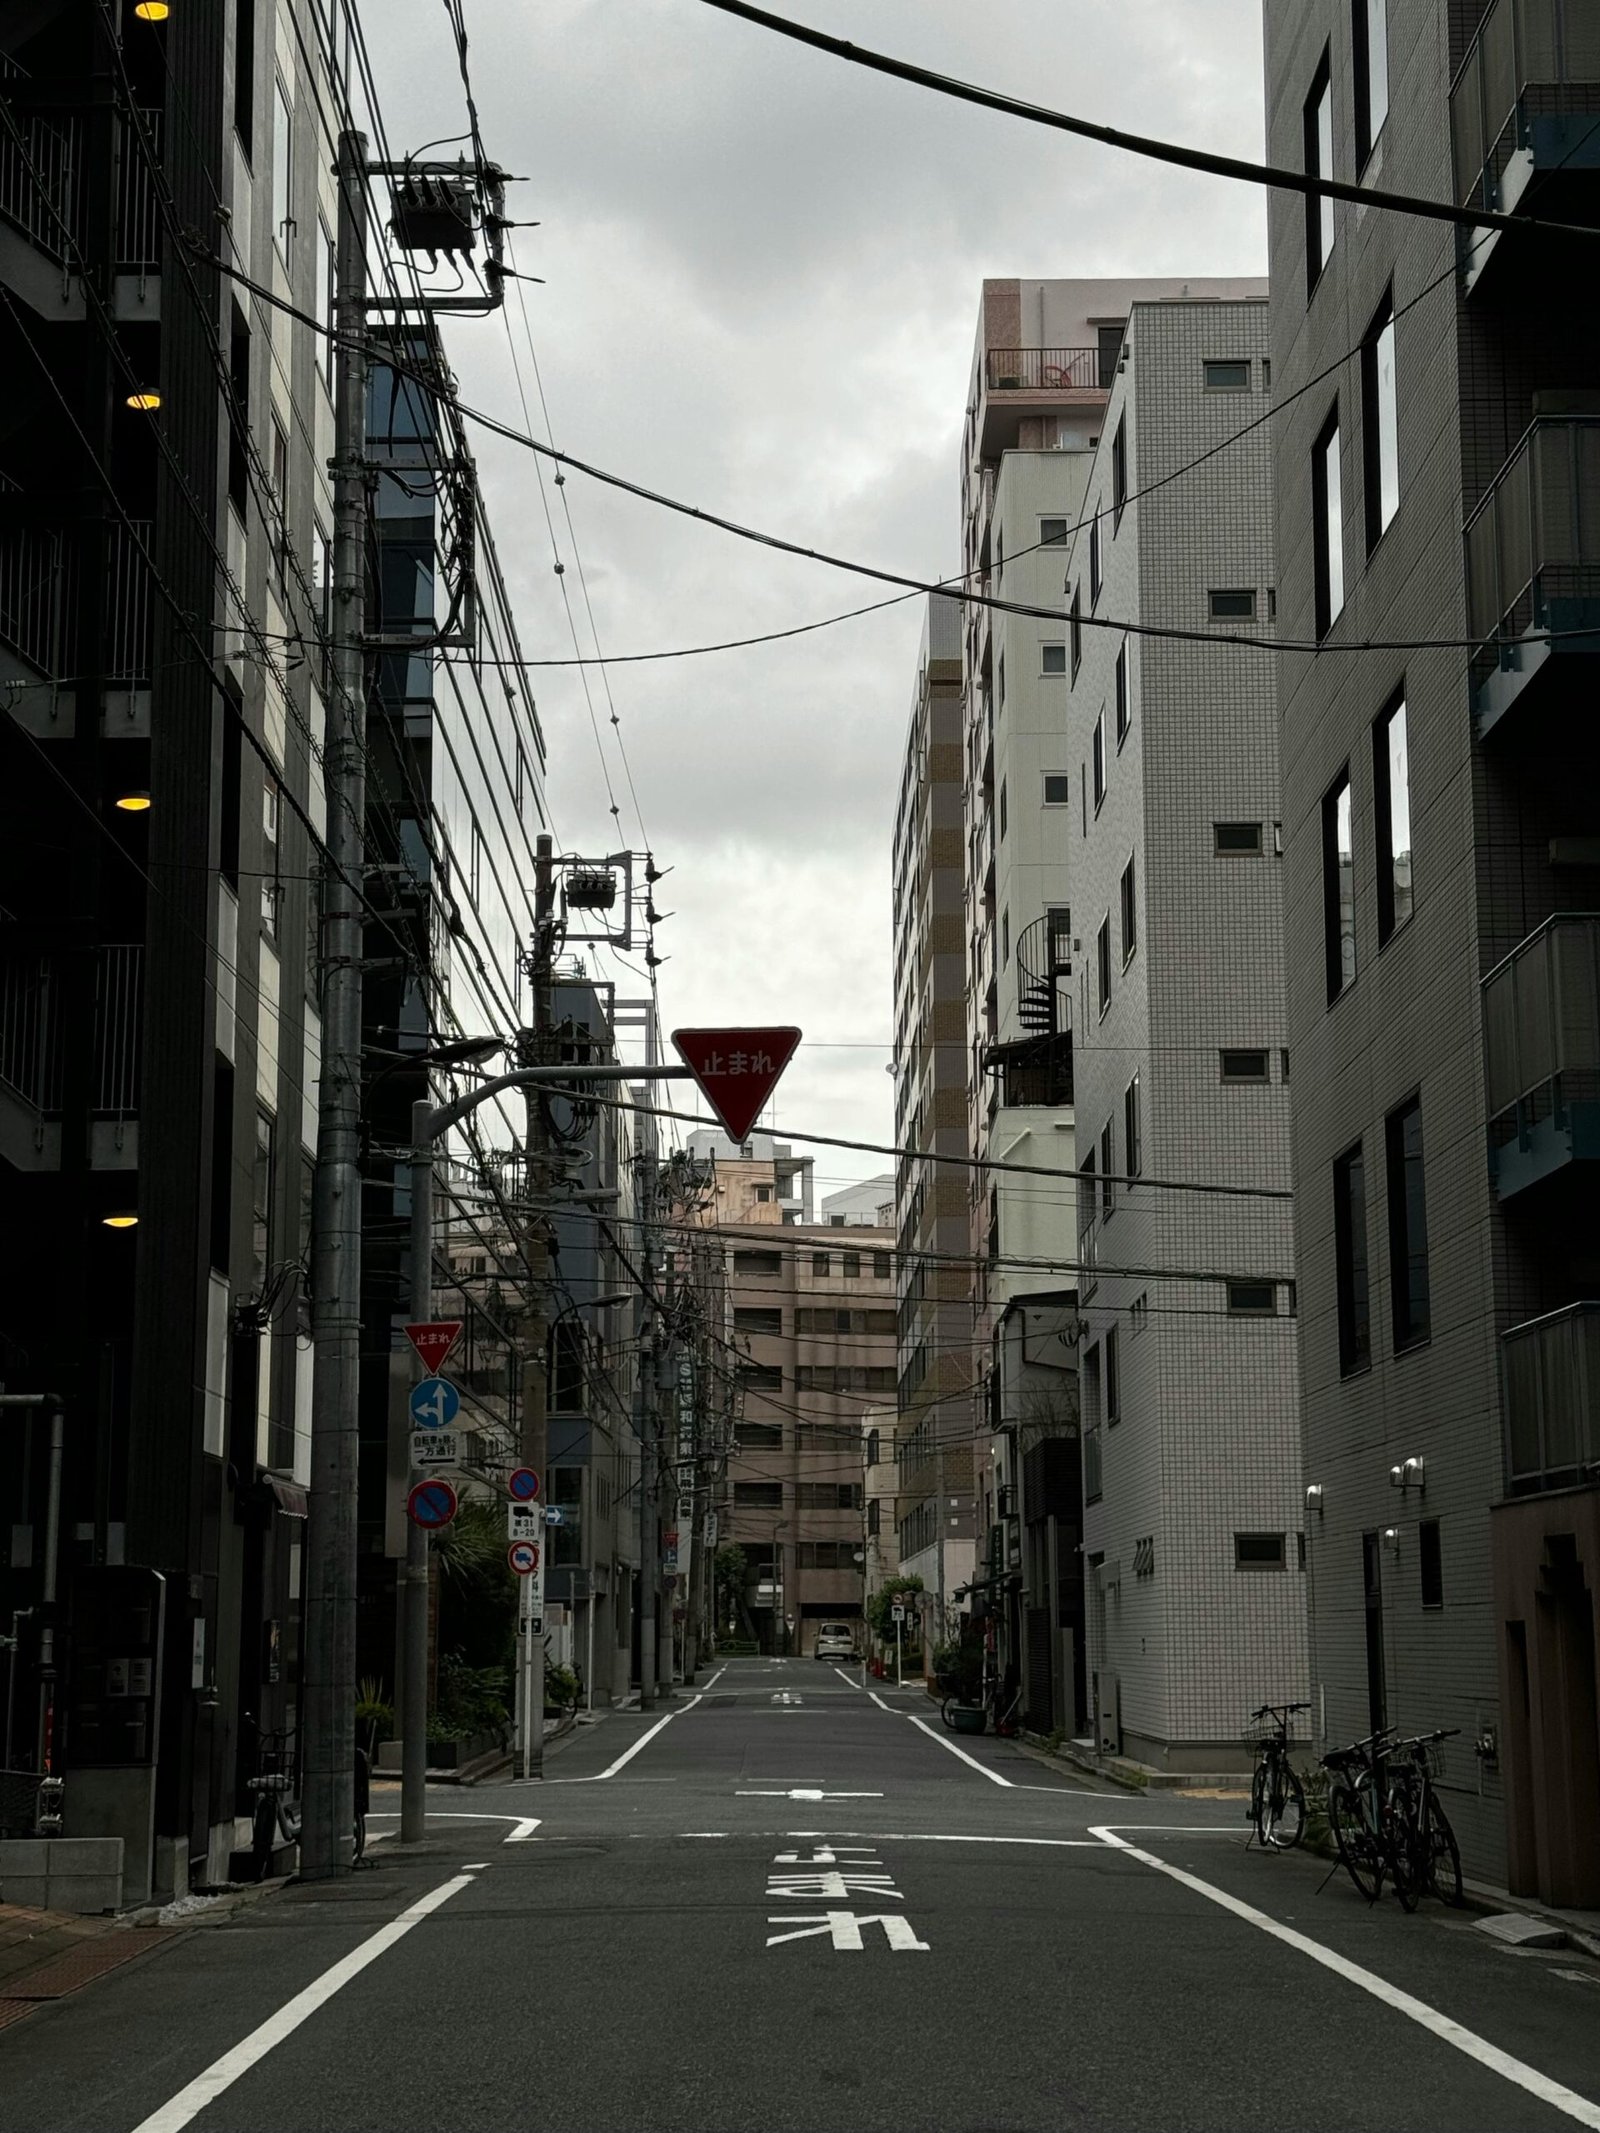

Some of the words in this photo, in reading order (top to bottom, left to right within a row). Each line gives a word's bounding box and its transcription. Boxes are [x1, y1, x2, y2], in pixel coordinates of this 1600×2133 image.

[701, 1050, 775, 1076] 止まれ
[416, 1333, 450, 1346] 止まれ
[414, 1446, 456, 1456] 一方通行
[766, 1845, 931, 1951] 止まれ
